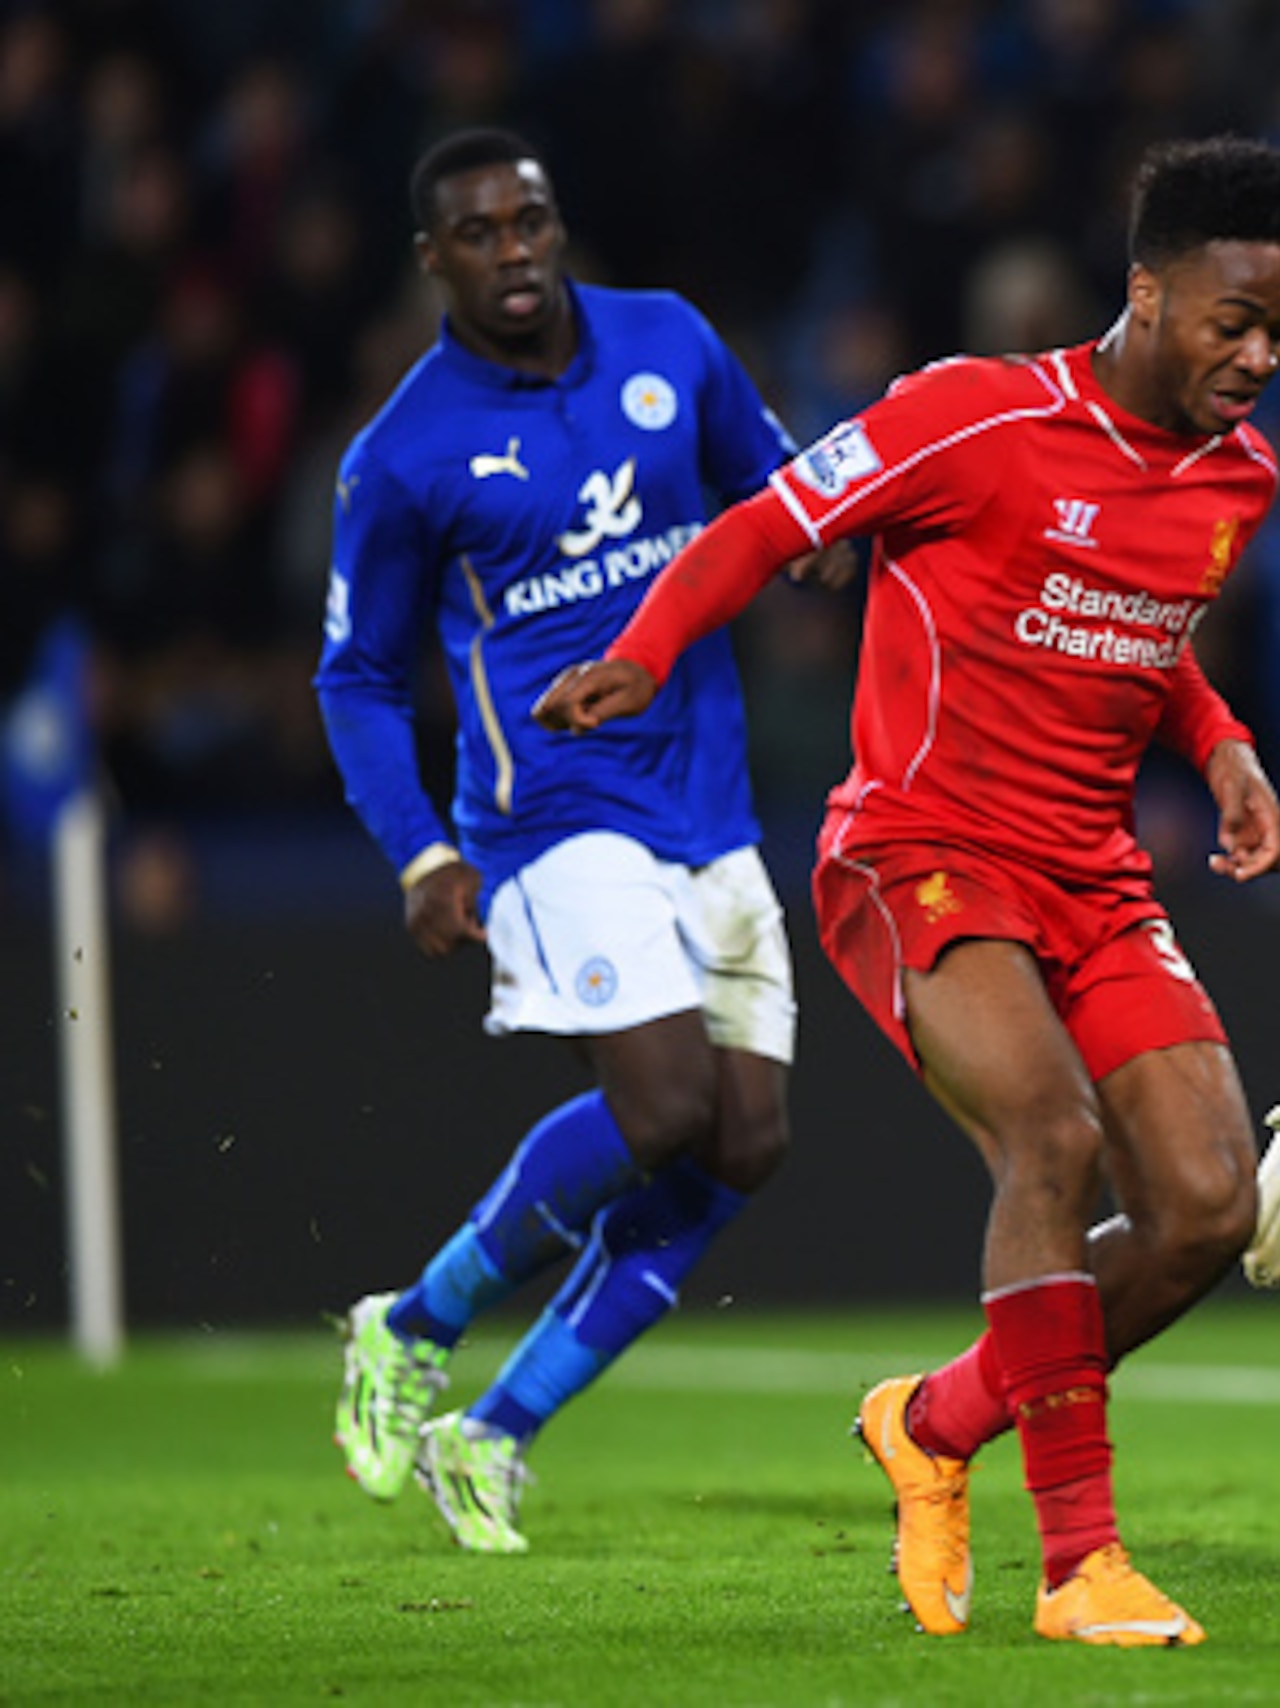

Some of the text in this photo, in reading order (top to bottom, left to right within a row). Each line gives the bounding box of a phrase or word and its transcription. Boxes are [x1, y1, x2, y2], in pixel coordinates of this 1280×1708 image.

[504, 559, 604, 616] KING
[1040, 572, 1190, 633] Standard
[1014, 606, 1178, 669] Chartered
